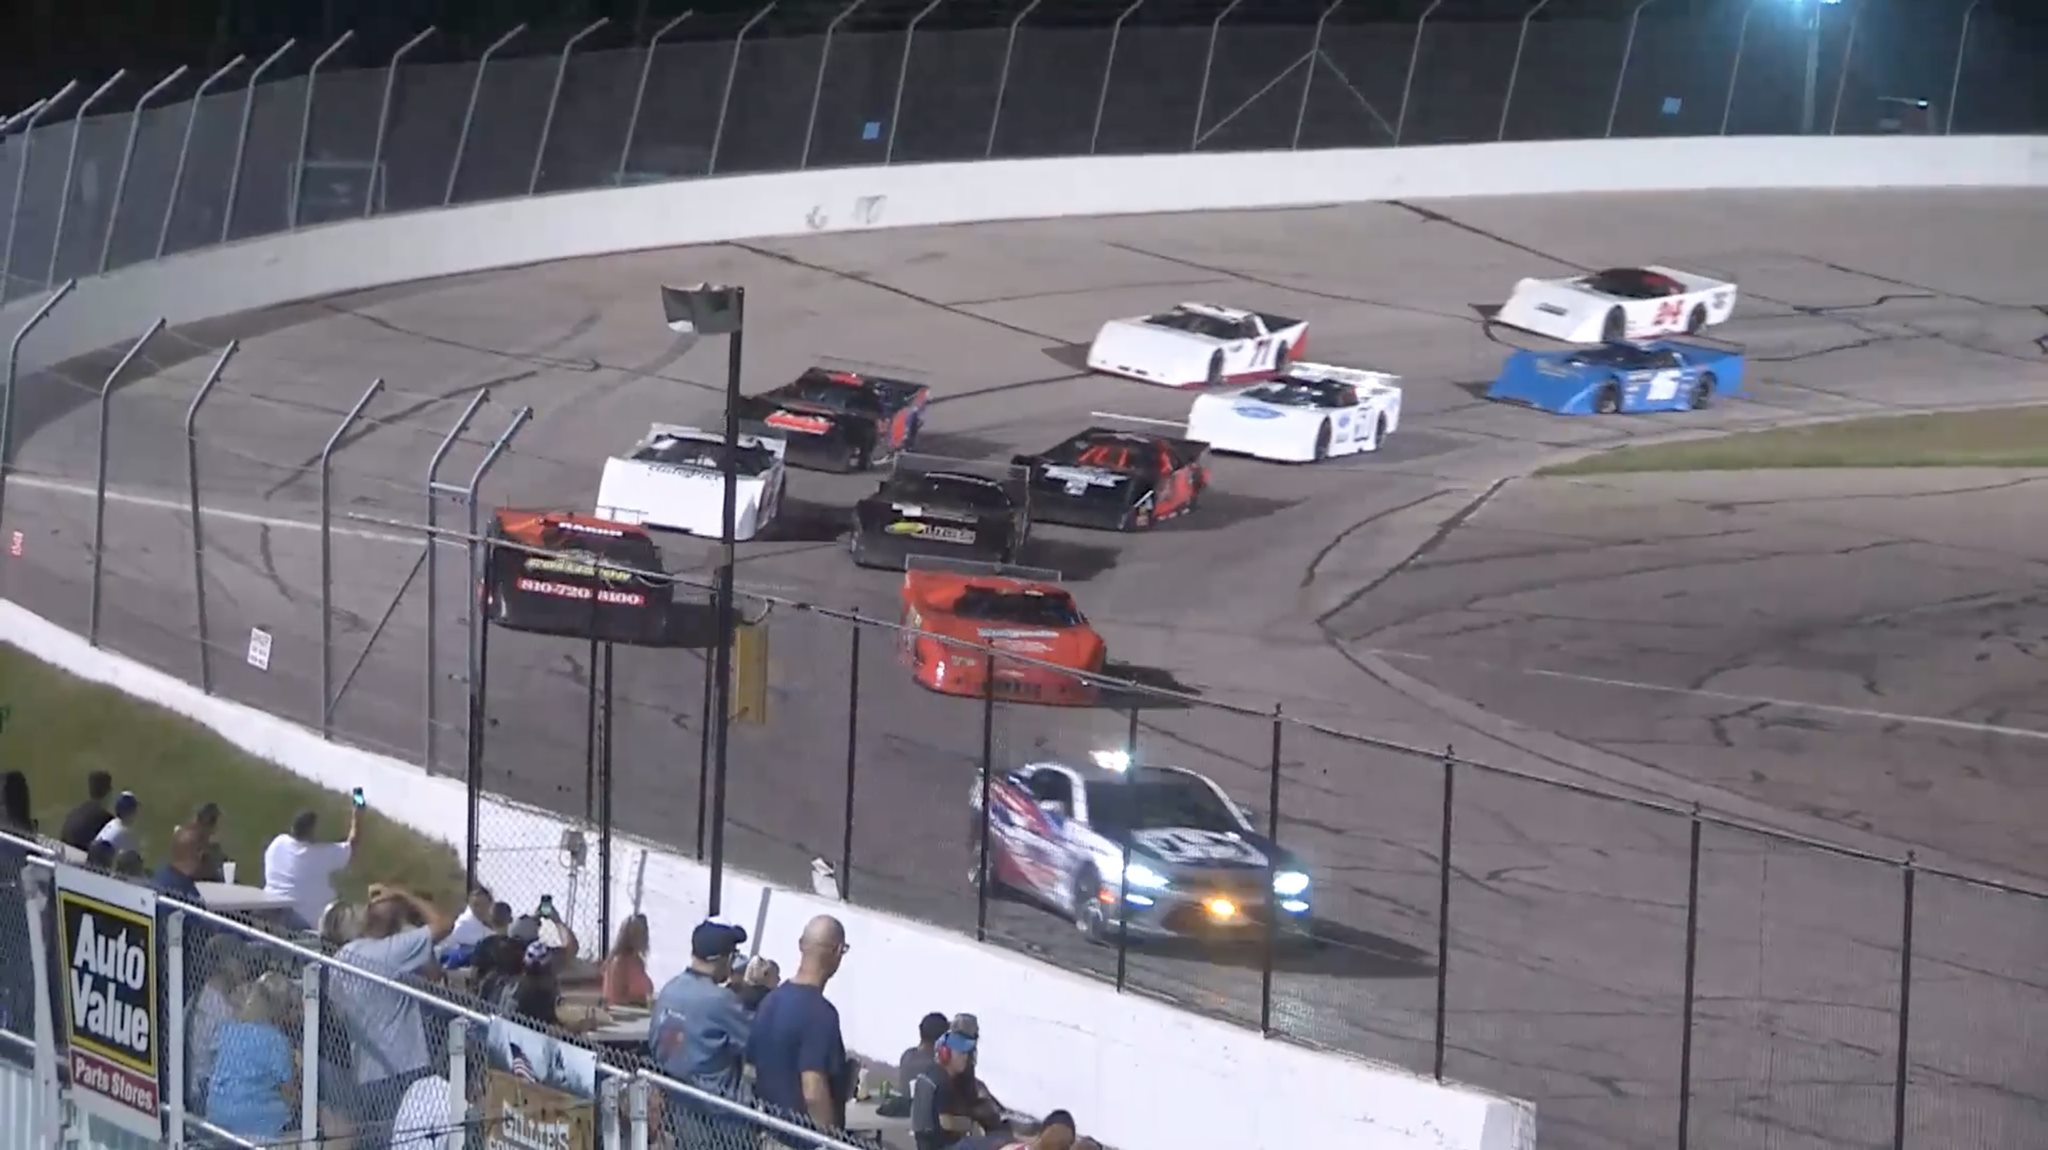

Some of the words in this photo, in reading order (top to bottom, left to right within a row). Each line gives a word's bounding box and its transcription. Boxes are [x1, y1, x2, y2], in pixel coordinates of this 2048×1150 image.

[520, 578, 642, 605] 810-7208100
[73, 912, 146, 990] Auto
[70, 967, 150, 1052] Value
[75, 1056, 110, 1091] Parts
